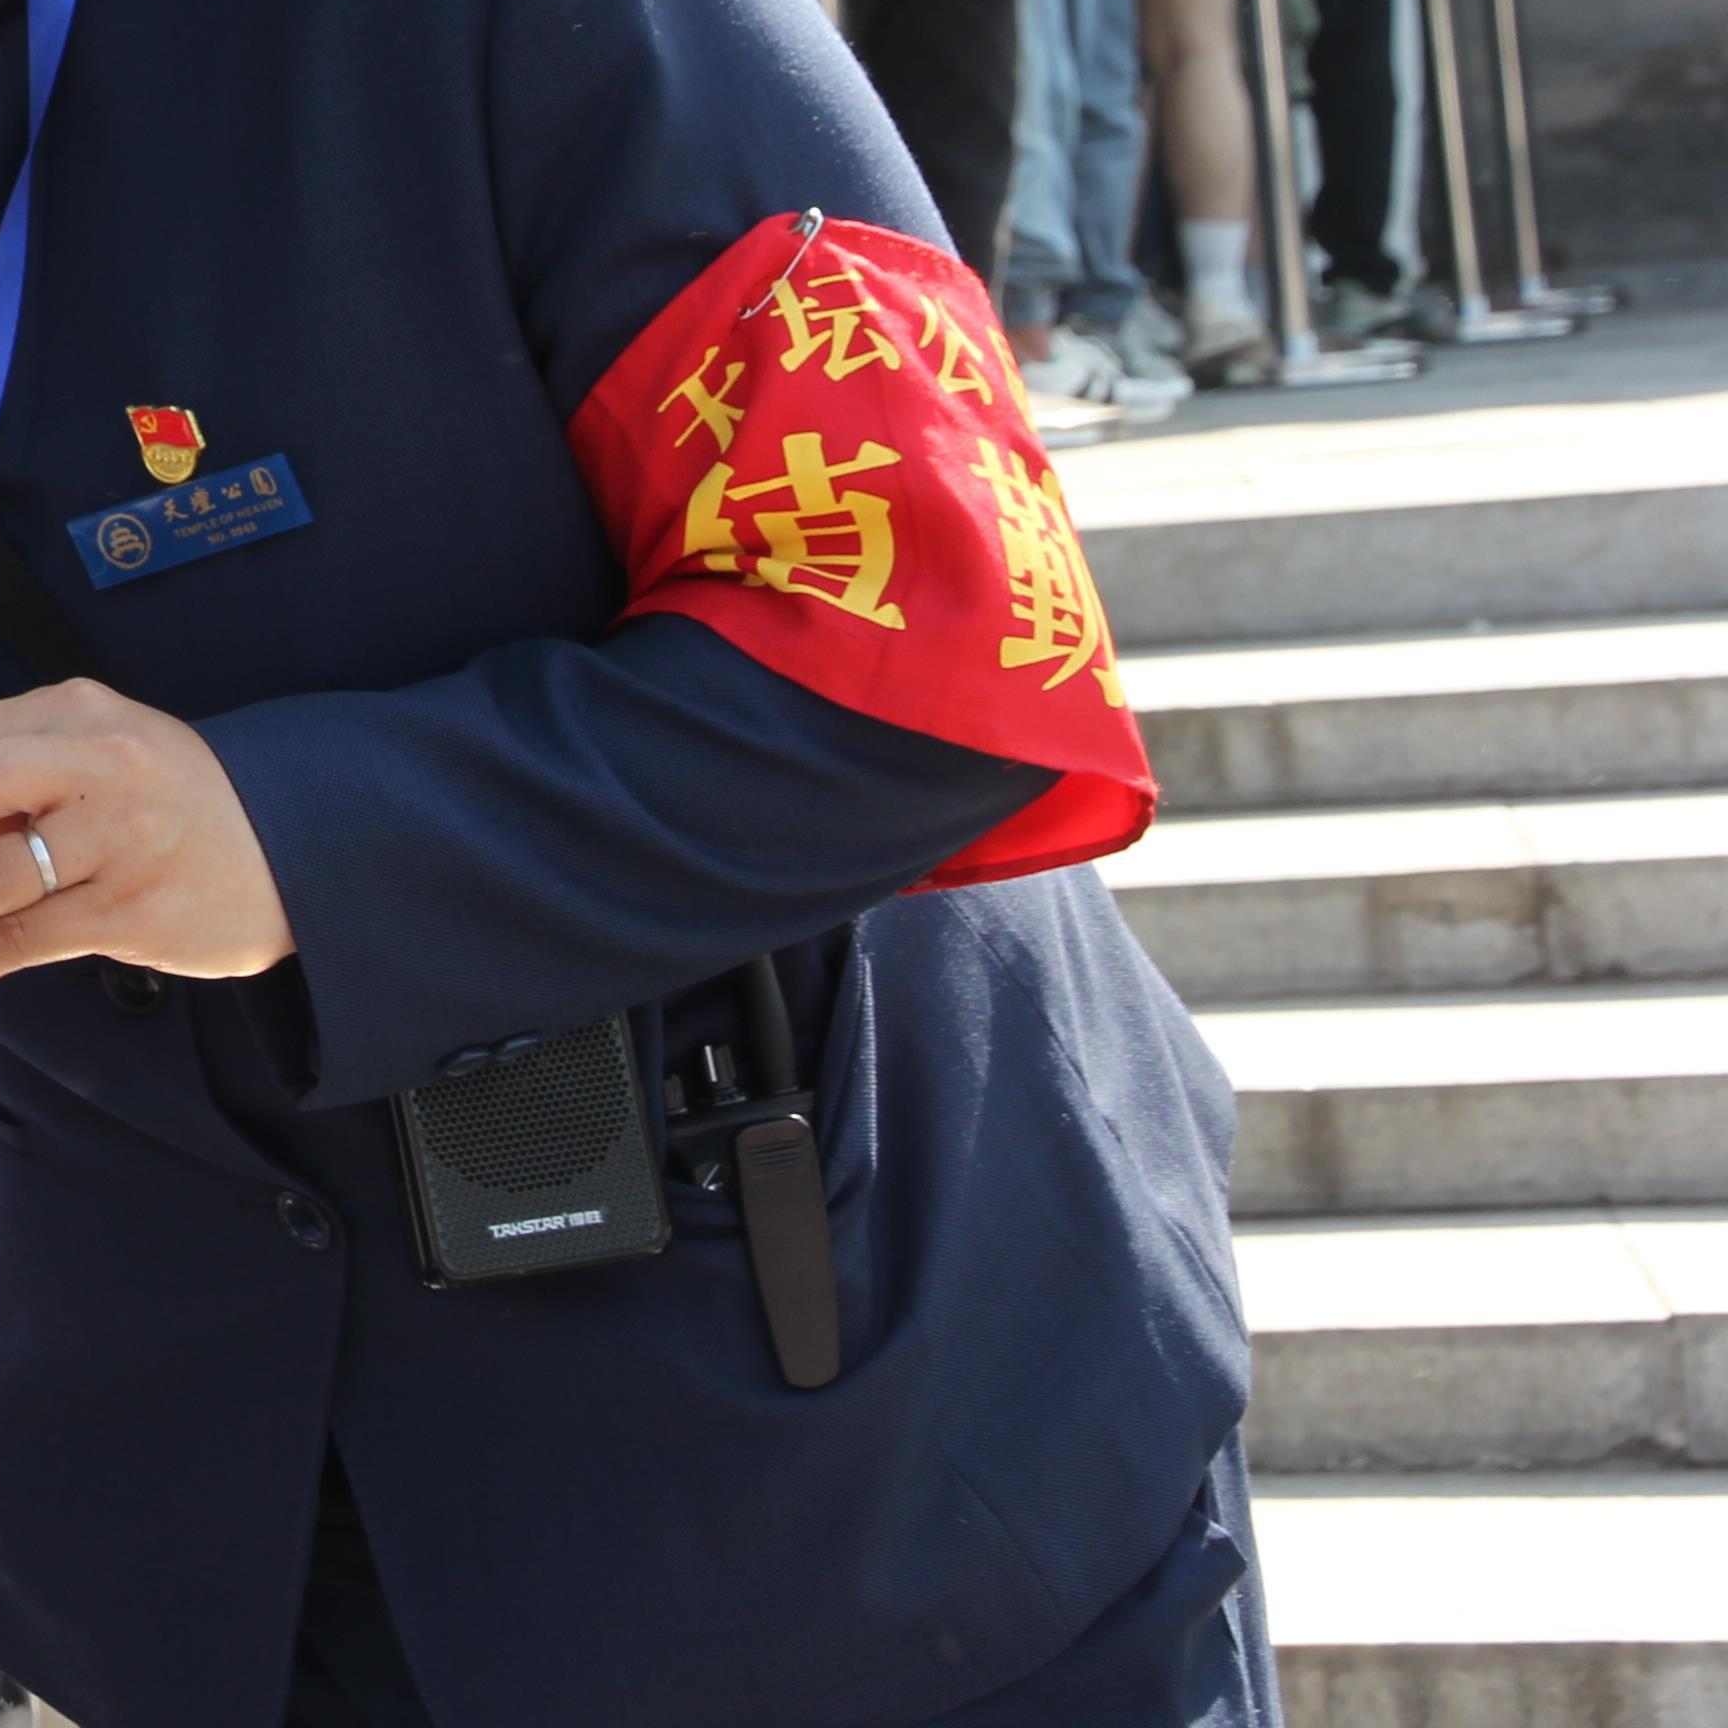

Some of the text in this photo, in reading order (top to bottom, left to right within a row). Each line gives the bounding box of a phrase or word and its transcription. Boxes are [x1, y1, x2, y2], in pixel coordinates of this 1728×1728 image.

[173, 516, 218, 539] TEMPLE
[235, 497, 284, 521] HEAVEN
[683, 431, 1126, 709] 值勤
[488, 1215, 566, 1239] TAKSTAR
